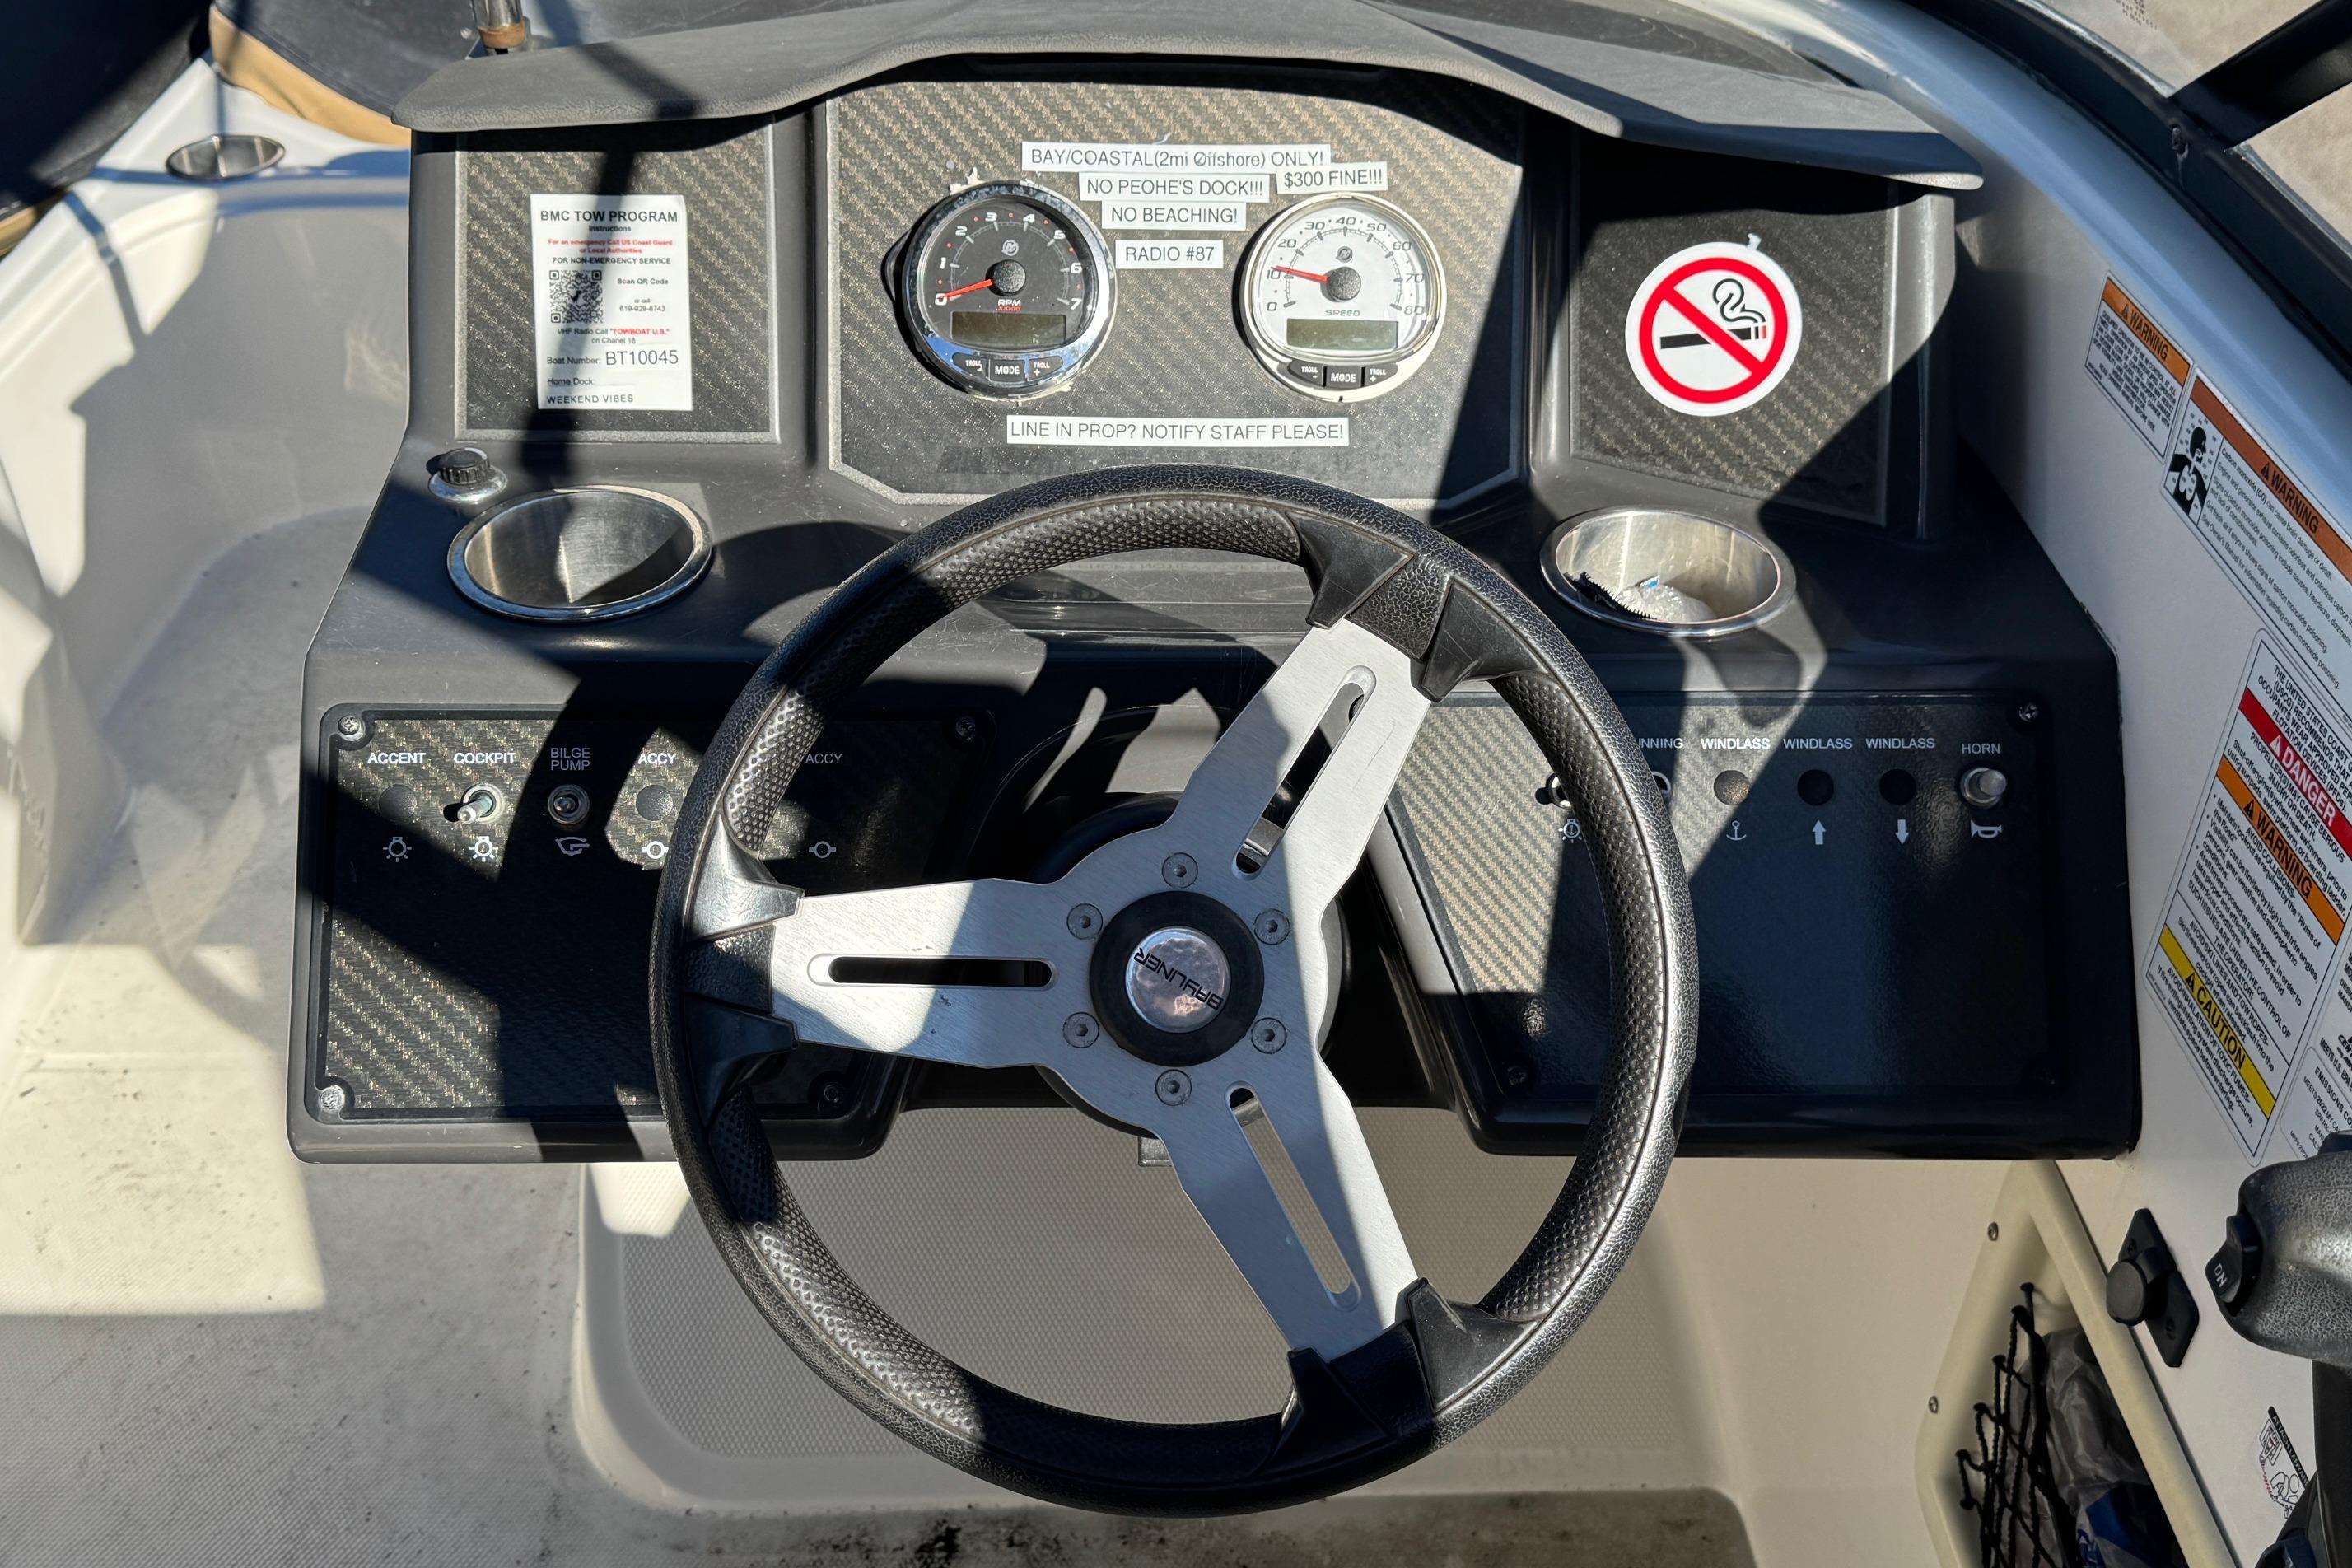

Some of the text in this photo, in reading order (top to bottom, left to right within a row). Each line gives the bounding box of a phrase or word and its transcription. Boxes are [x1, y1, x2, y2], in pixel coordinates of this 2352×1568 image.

[1271, 151, 1324, 166] ONLY!
[1284, 169, 1383, 187] $300 FINE!!!
[1087, 180, 1263, 195] NO PEOHE'S DOCK!!!
[541, 211, 677, 221] BMC TOW PROGRAM
[986, 212, 997, 222] 3
[1023, 214, 1034, 223] 4
[1112, 207, 1237, 223] NO BEACHING!
[955, 226, 967, 236] 2
[1304, 222, 1325, 230] 30
[1366, 223, 1386, 231] 50
[1054, 230, 1066, 239] 5
[1278, 239, 1296, 248] 20
[1393, 242, 1412, 250] 60
[1126, 246, 1215, 261] RADIO #87
[940, 257, 946, 269] 1
[1071, 262, 1082, 273] 6
[1406, 273, 1424, 283] 70
[1071, 298, 1082, 310] 7
[1267, 302, 1277, 311] 0
[1404, 306, 1424, 315] 80
[2129, 309, 2168, 362] WARNING
[606, 350, 678, 365] BT10045
[995, 365, 1020, 375] MODE
[1331, 373, 1356, 382] MODE
[547, 395, 599, 404] WEEKEND
[1011, 422, 1343, 440] LINE IN PROP? NOTIFY STAFF PLEASE!
[2270, 469, 2319, 535] WARNING
[2273, 665, 2349, 765] THE UNITED STATES COAST
[2257, 674, 2340, 786] OCCUPANTS WEAR APPROVED
[2273, 679, 2350, 782] (USCG) RECOMMENDS THAT
[1701, 738, 1770, 749] WINDLASS
[1784, 738, 1852, 749] WINDLASS
[1866, 738, 1934, 749] WINDLASS
[1962, 744, 2001, 754] HORN
[2271, 707, 2303, 753] FLOTATION
[2302, 747, 2327, 785] DEVICES
[367, 753, 425, 764] ACCENT
[454, 752, 516, 764] COCKPIT
[550, 748, 590, 759] BILGE
[637, 753, 677, 765] ACCY
[805, 753, 842, 765] ACCY
[550, 759, 590, 771] PUMP
[2281, 744, 2336, 828] DANGER
[2249, 730, 2289, 790] PROPELLER(S)
[2298, 797, 2320, 830] CAUSE
[2317, 824, 2345, 864] SERIOUS
[2268, 771, 2289, 803] INJURY
[2295, 808, 2317, 842] DEATH.
[2245, 825, 2263, 855] AVOID
[2255, 810, 2313, 899] WARNING
[2200, 898, 2219, 931] ISSUES
[2228, 941, 2247, 974] UNDER
[2256, 984, 2282, 1029] CONTROL
[1133, 948, 1224, 1011] BAYLINER
[2196, 983, 2246, 1071] CAUTION
[2314, 1065, 2344, 1113] EMISSIONS
[2214, 1263, 2227, 1287] DN
